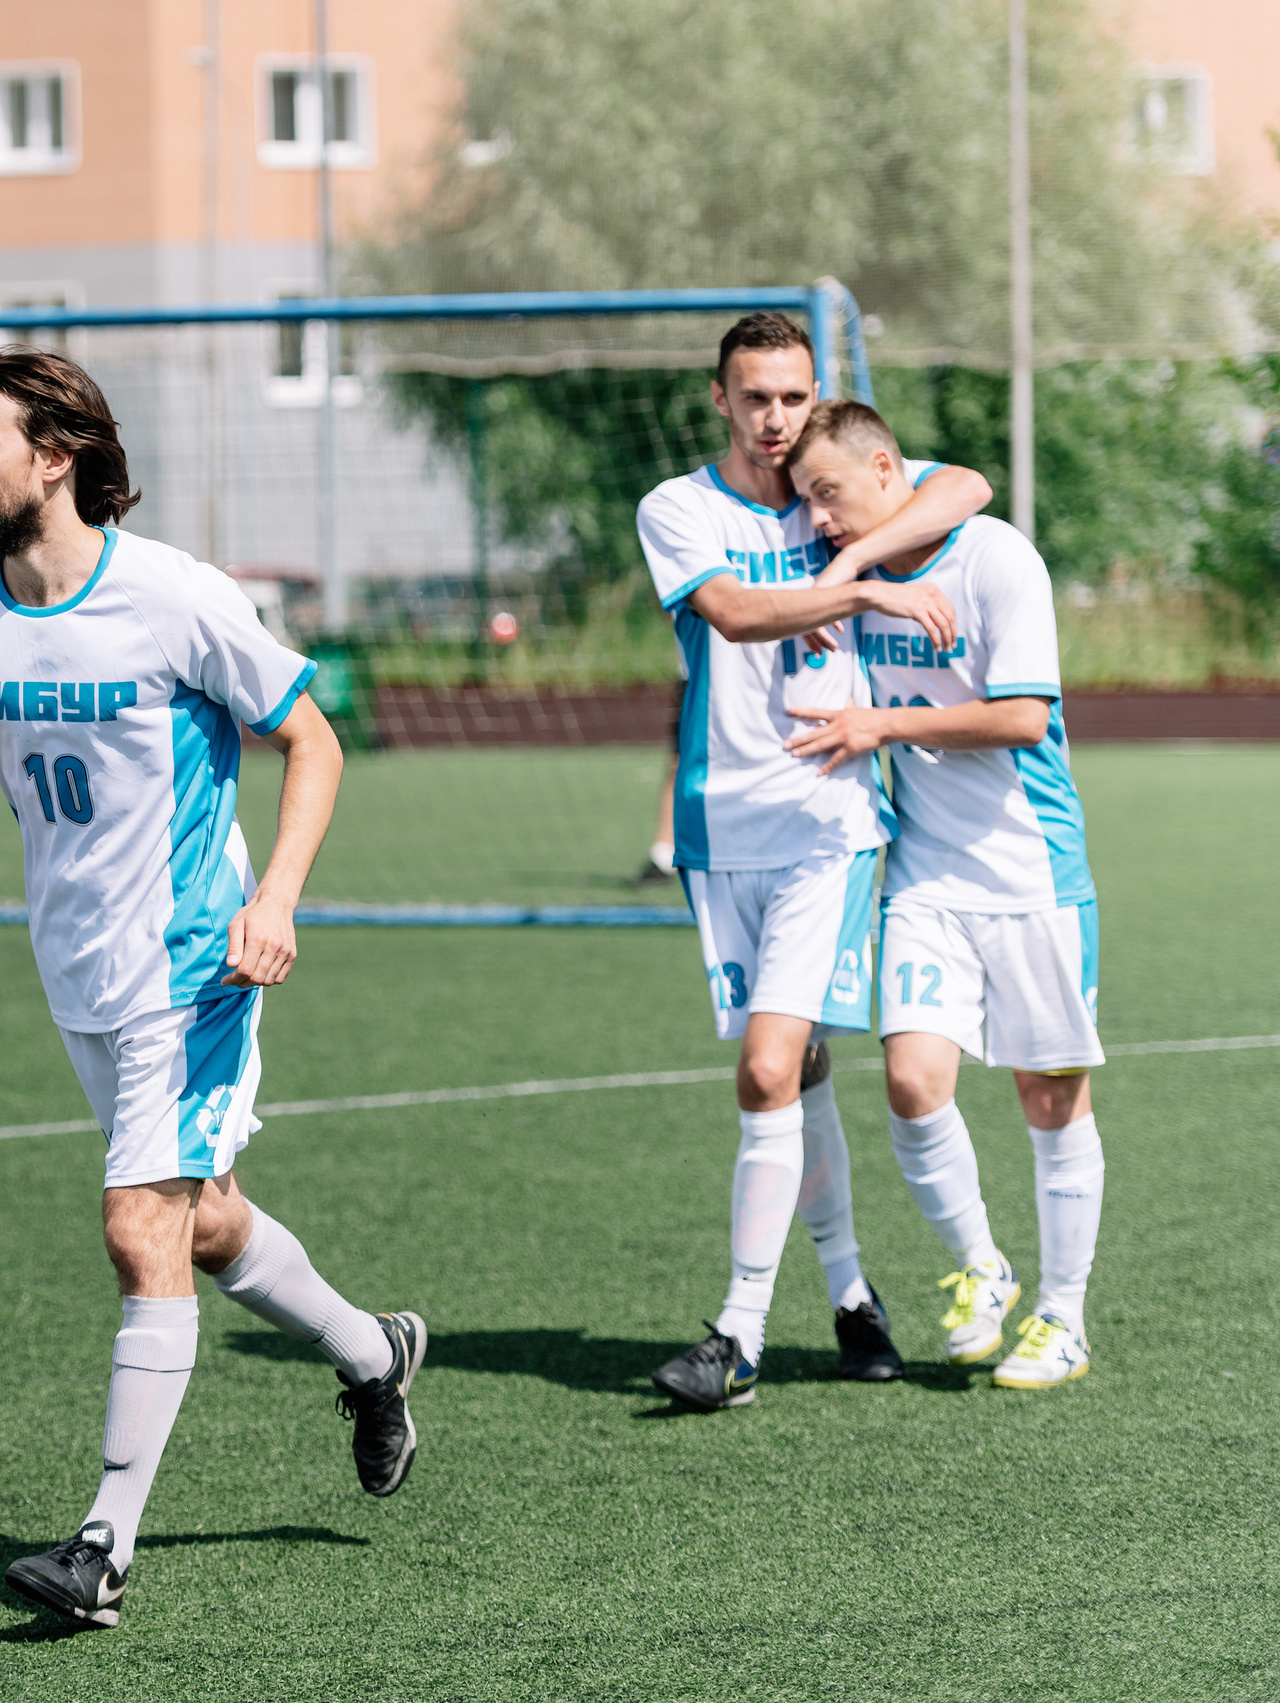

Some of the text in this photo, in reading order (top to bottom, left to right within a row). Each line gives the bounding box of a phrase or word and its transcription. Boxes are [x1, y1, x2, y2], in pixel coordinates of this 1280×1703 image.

[864, 633, 965, 668] ИБУР
[23, 752, 96, 826] 10
[896, 962, 942, 1006] 12
[81, 1528, 108, 1542] NIKE
